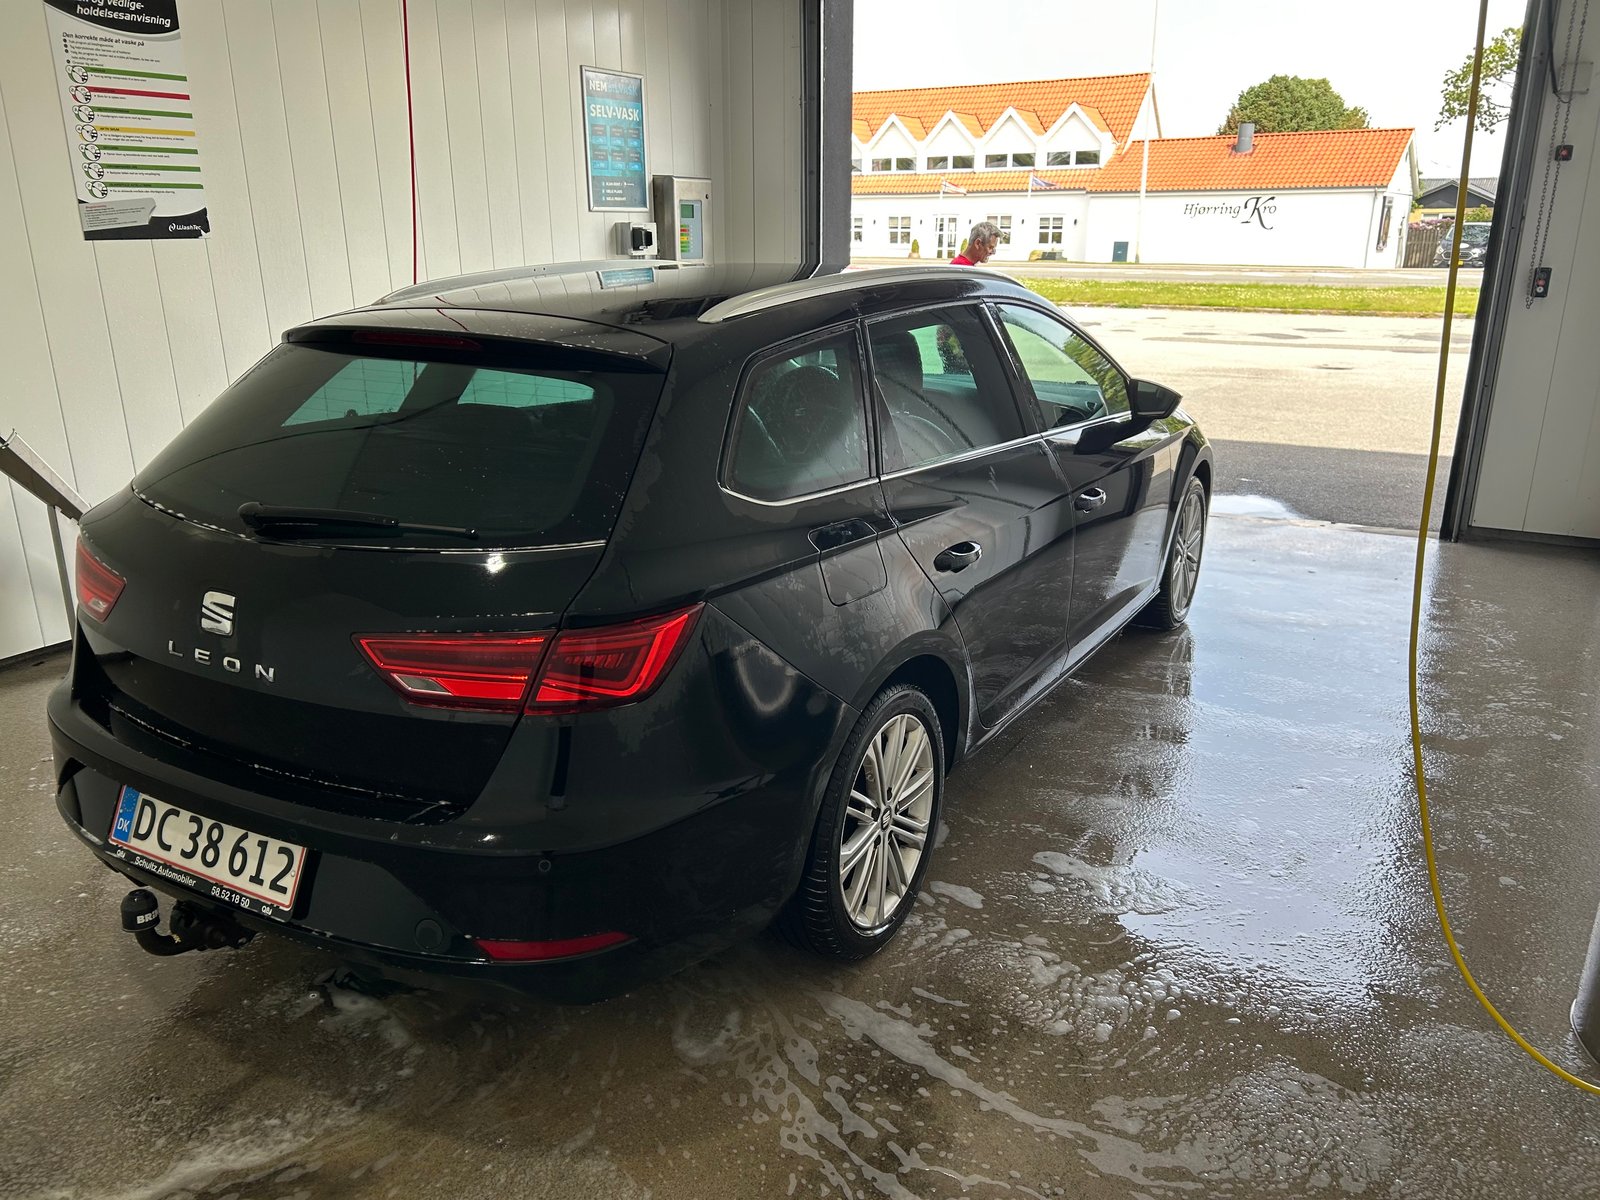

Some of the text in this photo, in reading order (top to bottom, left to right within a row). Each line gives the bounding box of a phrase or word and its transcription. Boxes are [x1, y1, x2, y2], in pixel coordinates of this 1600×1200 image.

[107, 0, 144, 10] vedlige-
[76, 4, 171, 28] holdelsesanvisning
[75, 33, 98, 41] korrekte
[590, 104, 639, 122] SELV-VASK
[1183, 196, 1277, 230] Hjørring Kro
[168, 640, 275, 683] LEON
[117, 817, 131, 833] DK
[134, 856, 197, 887] Schultz Automobiler
